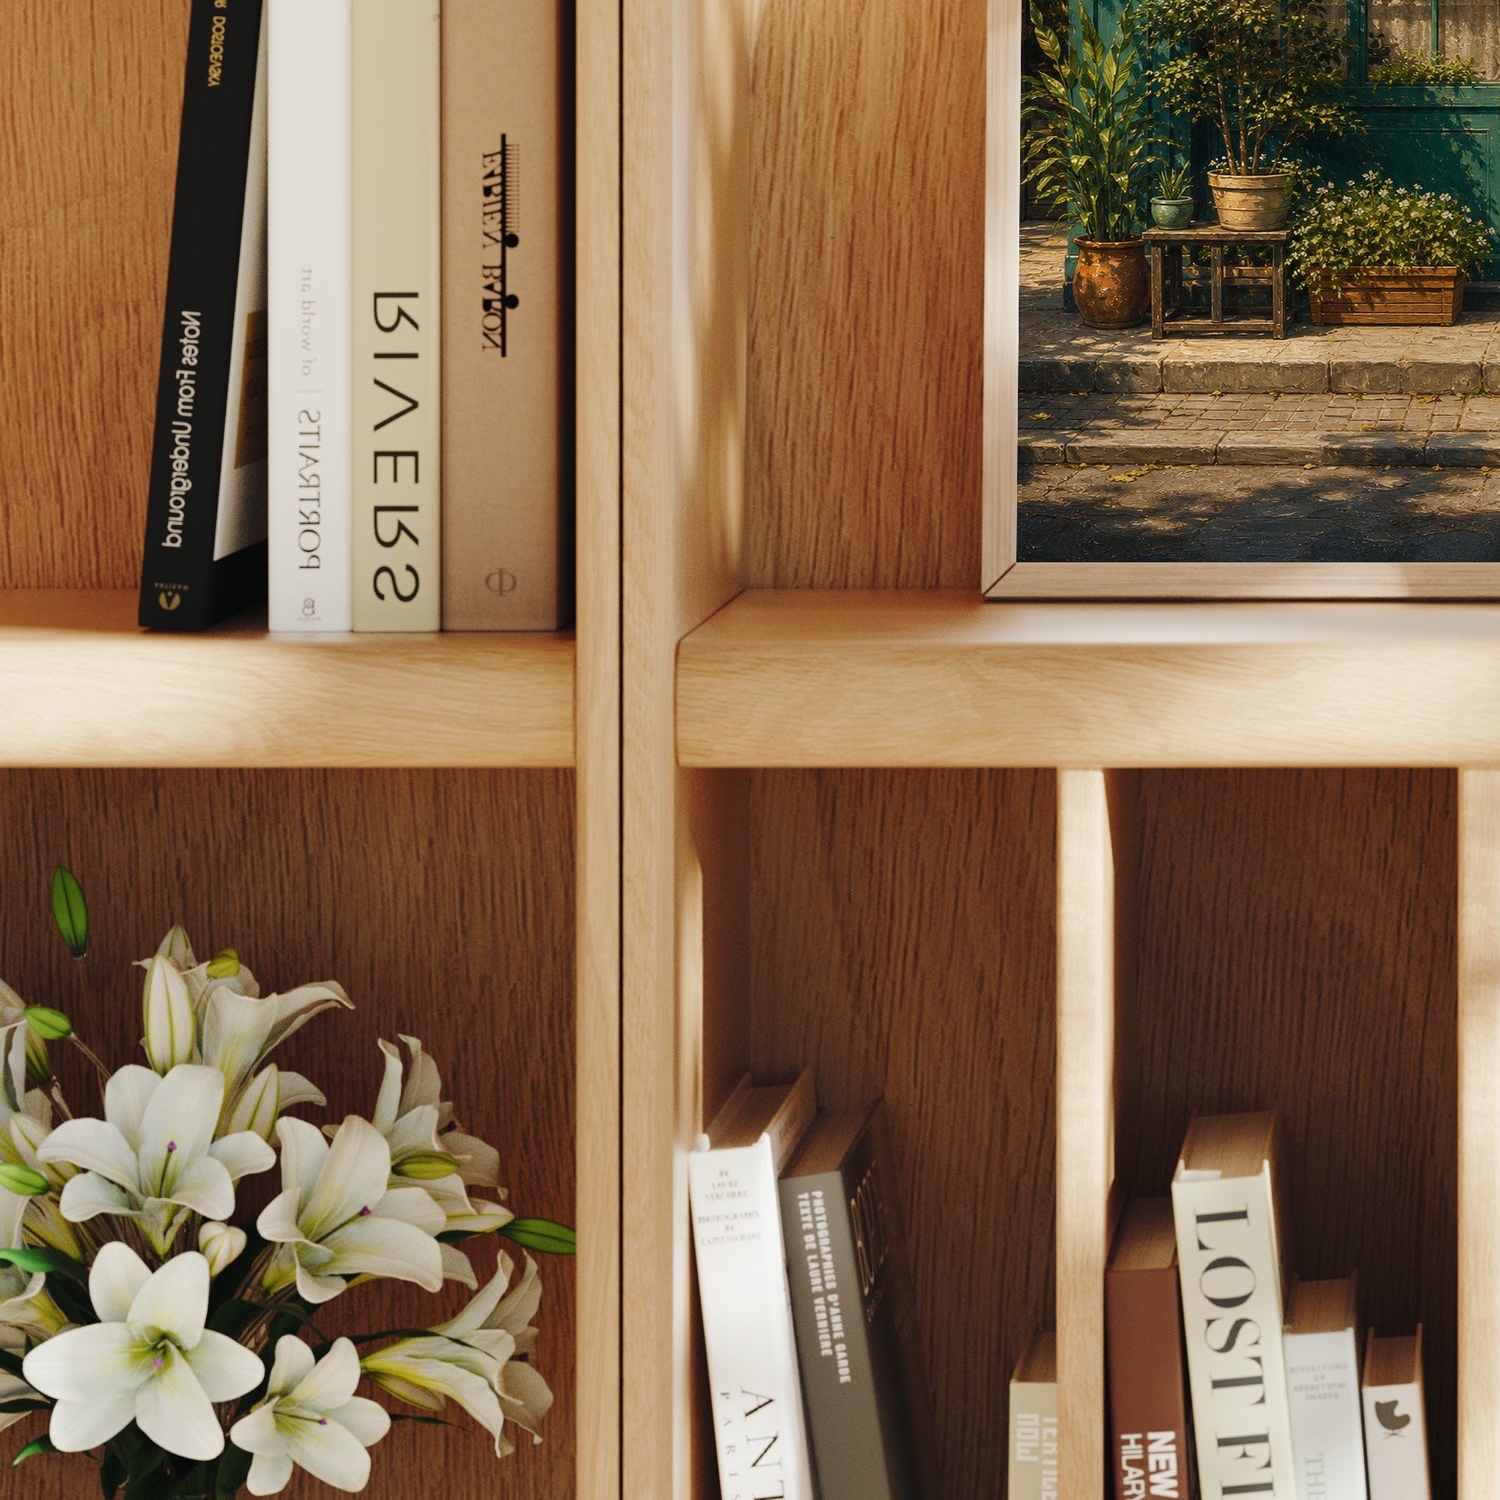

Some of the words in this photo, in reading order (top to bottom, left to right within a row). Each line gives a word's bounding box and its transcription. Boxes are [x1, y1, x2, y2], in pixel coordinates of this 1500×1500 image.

[797, 1191, 814, 1231] TEXTE
[803, 1233, 818, 1251] DE
[811, 1190, 838, 1290] PHOTOGRAPHIES
[806, 1254, 824, 1294] LAURE
[1194, 1203, 1266, 1406] LOST
[1146, 1430, 1179, 1499] NEW
